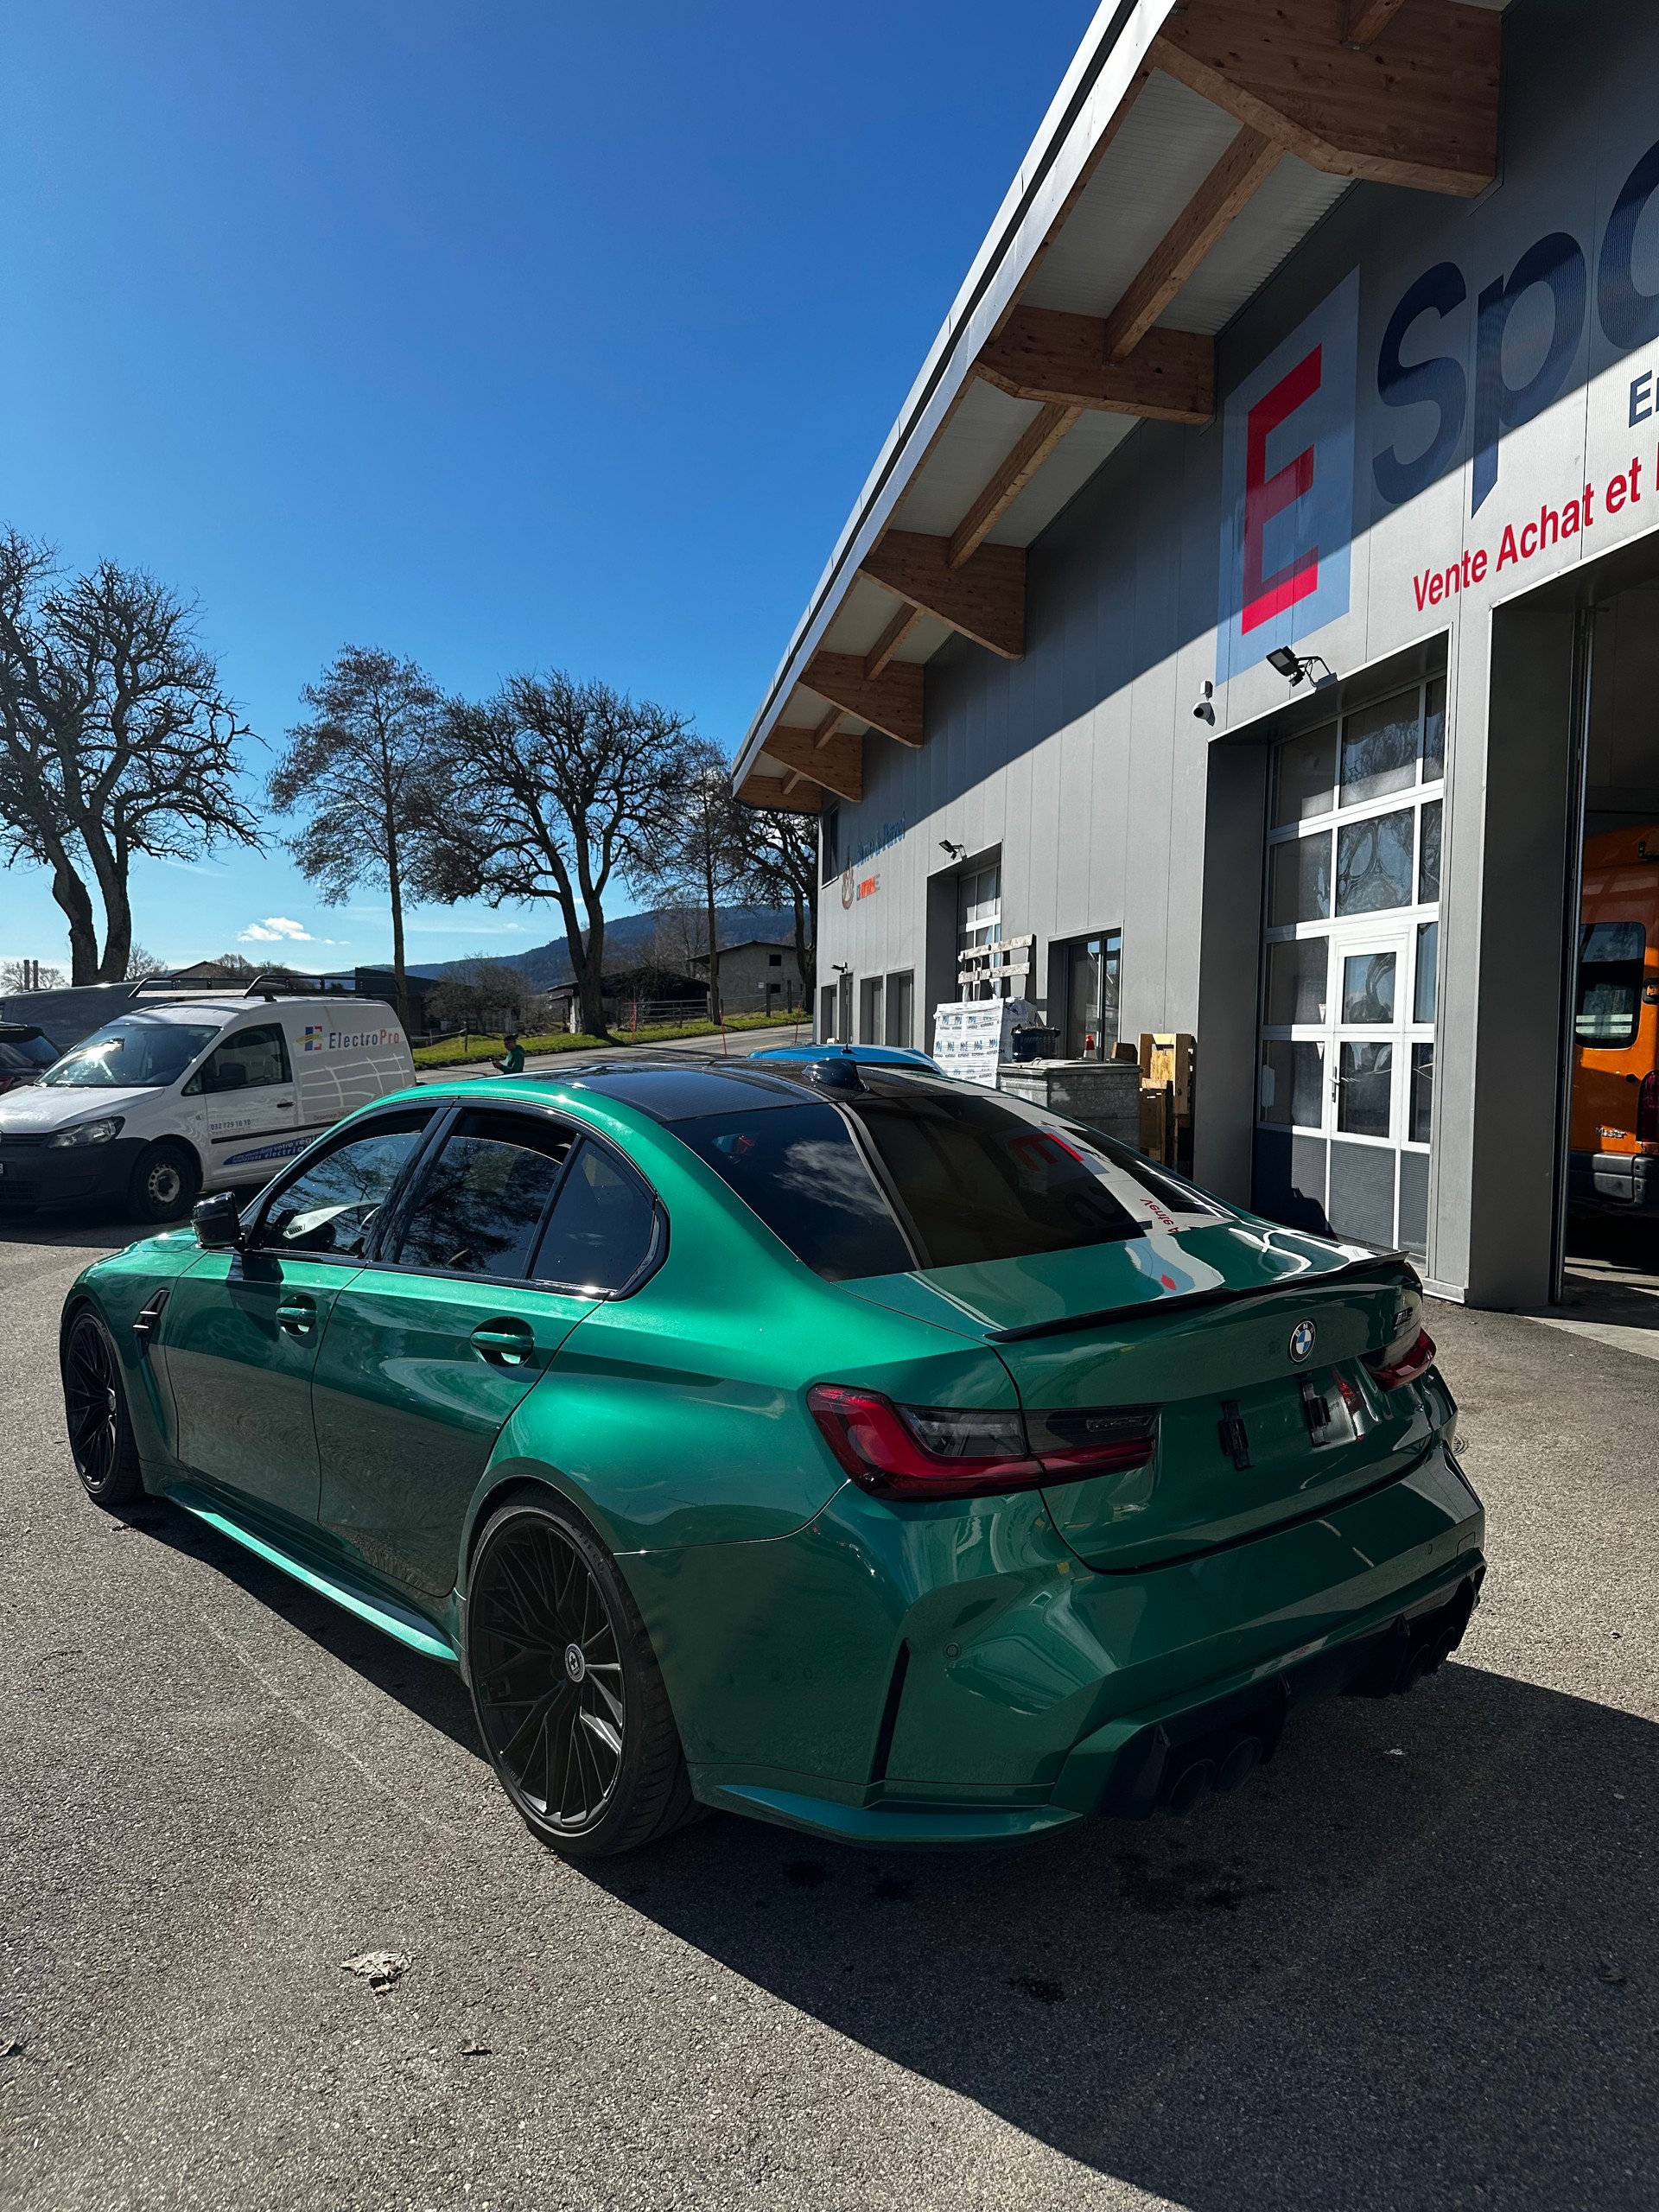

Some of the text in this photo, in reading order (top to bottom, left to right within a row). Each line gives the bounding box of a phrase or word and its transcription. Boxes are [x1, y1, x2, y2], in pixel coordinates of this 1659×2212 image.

[1629, 370, 1659, 428] E
[1414, 549, 1487, 612] Vente
[1496, 482, 1594, 572] Achat
[1605, 456, 1642, 514] et
[329, 1029, 399, 1049] ElectroPro
[274, 1142, 294, 1151] votre
